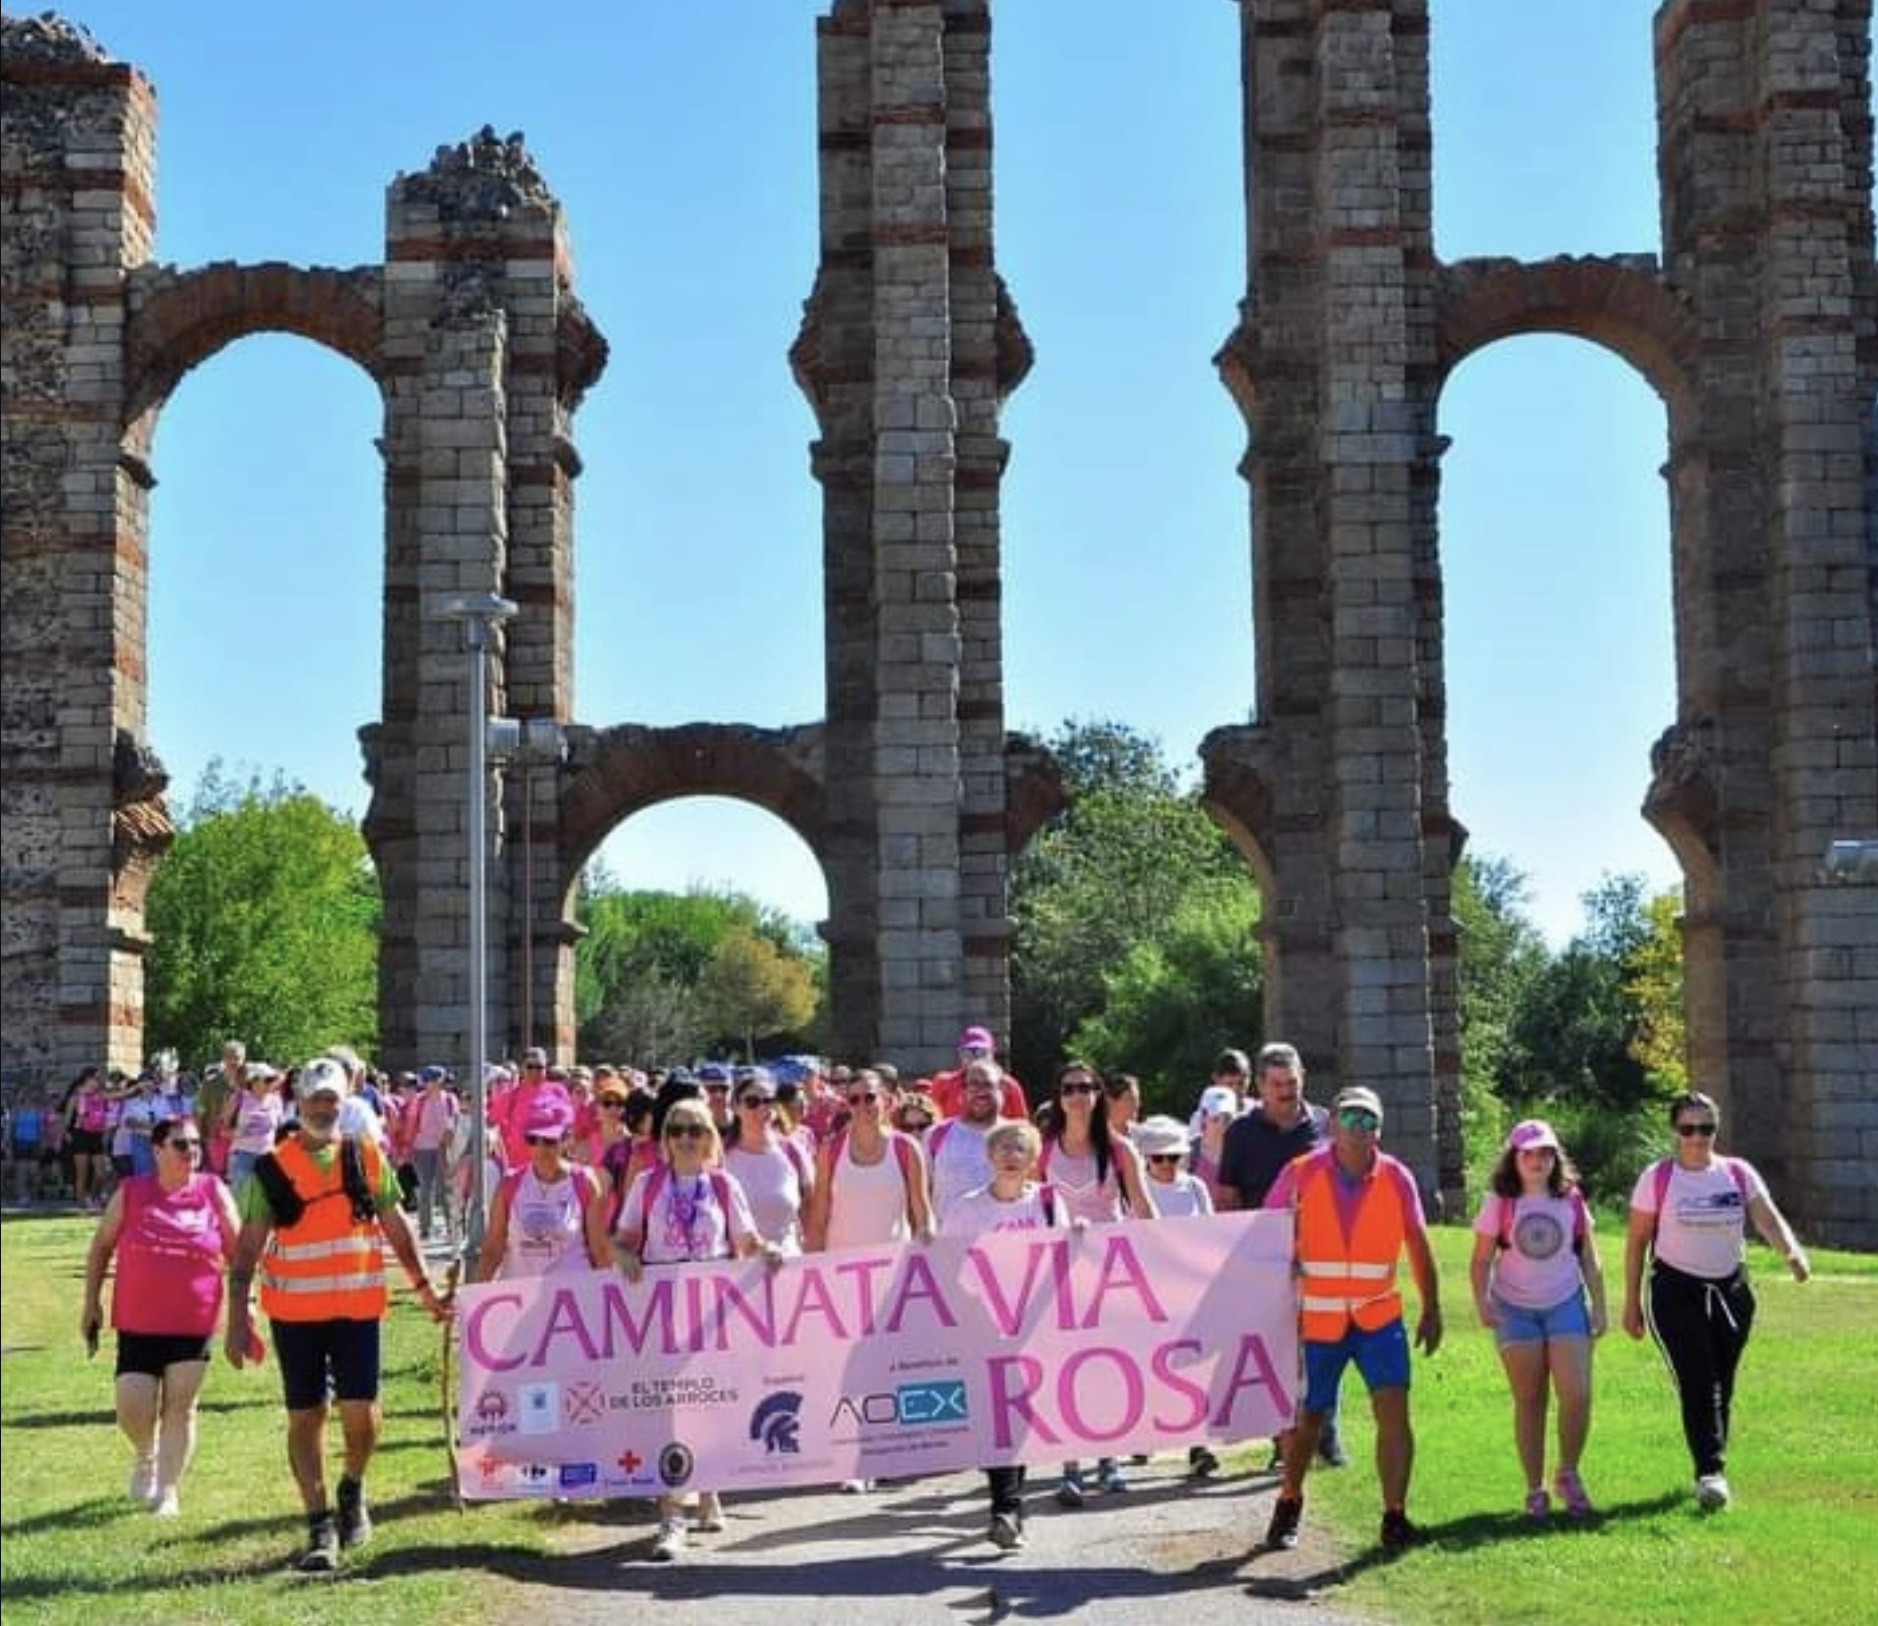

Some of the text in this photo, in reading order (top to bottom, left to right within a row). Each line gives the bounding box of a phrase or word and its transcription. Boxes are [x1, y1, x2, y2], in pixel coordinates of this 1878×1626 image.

[467, 1235, 1169, 1372] CAMINATA VIA
[610, 1395, 630, 1410] DE
[633, 1393, 662, 1408] LOS
[632, 1377, 714, 1394] EL TEMPLO
[986, 1333, 1294, 1450] ROSA
